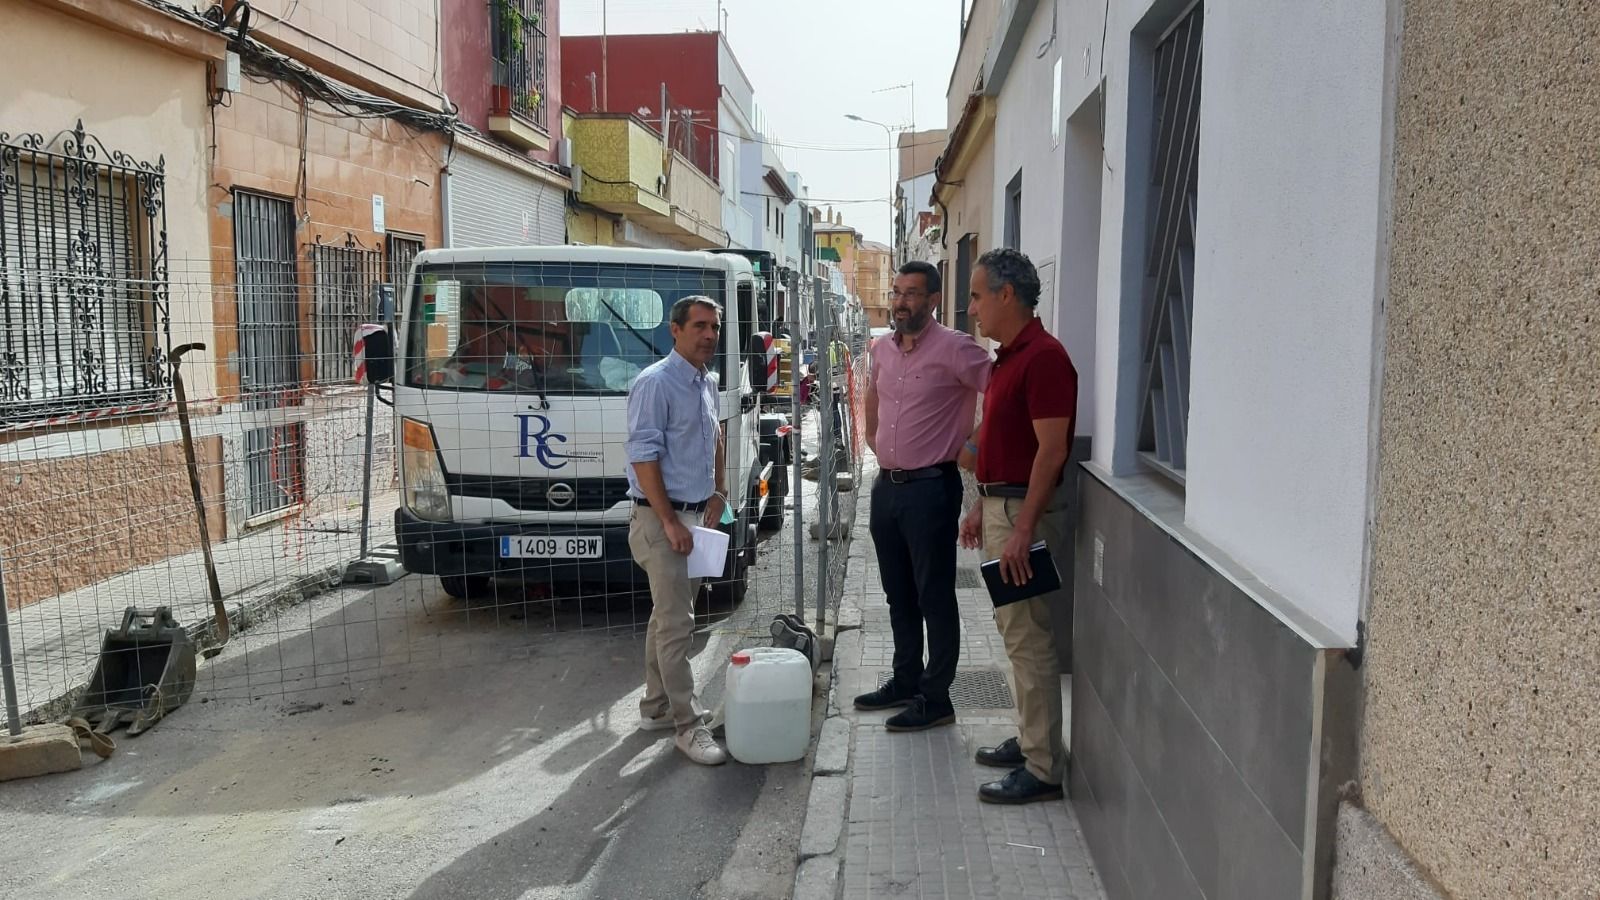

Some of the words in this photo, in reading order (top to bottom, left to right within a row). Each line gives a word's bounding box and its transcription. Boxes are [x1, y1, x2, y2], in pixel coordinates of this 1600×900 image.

[513, 414, 567, 469] RC
[517, 539, 557, 555] 1409
[566, 539, 598, 555] GBW
